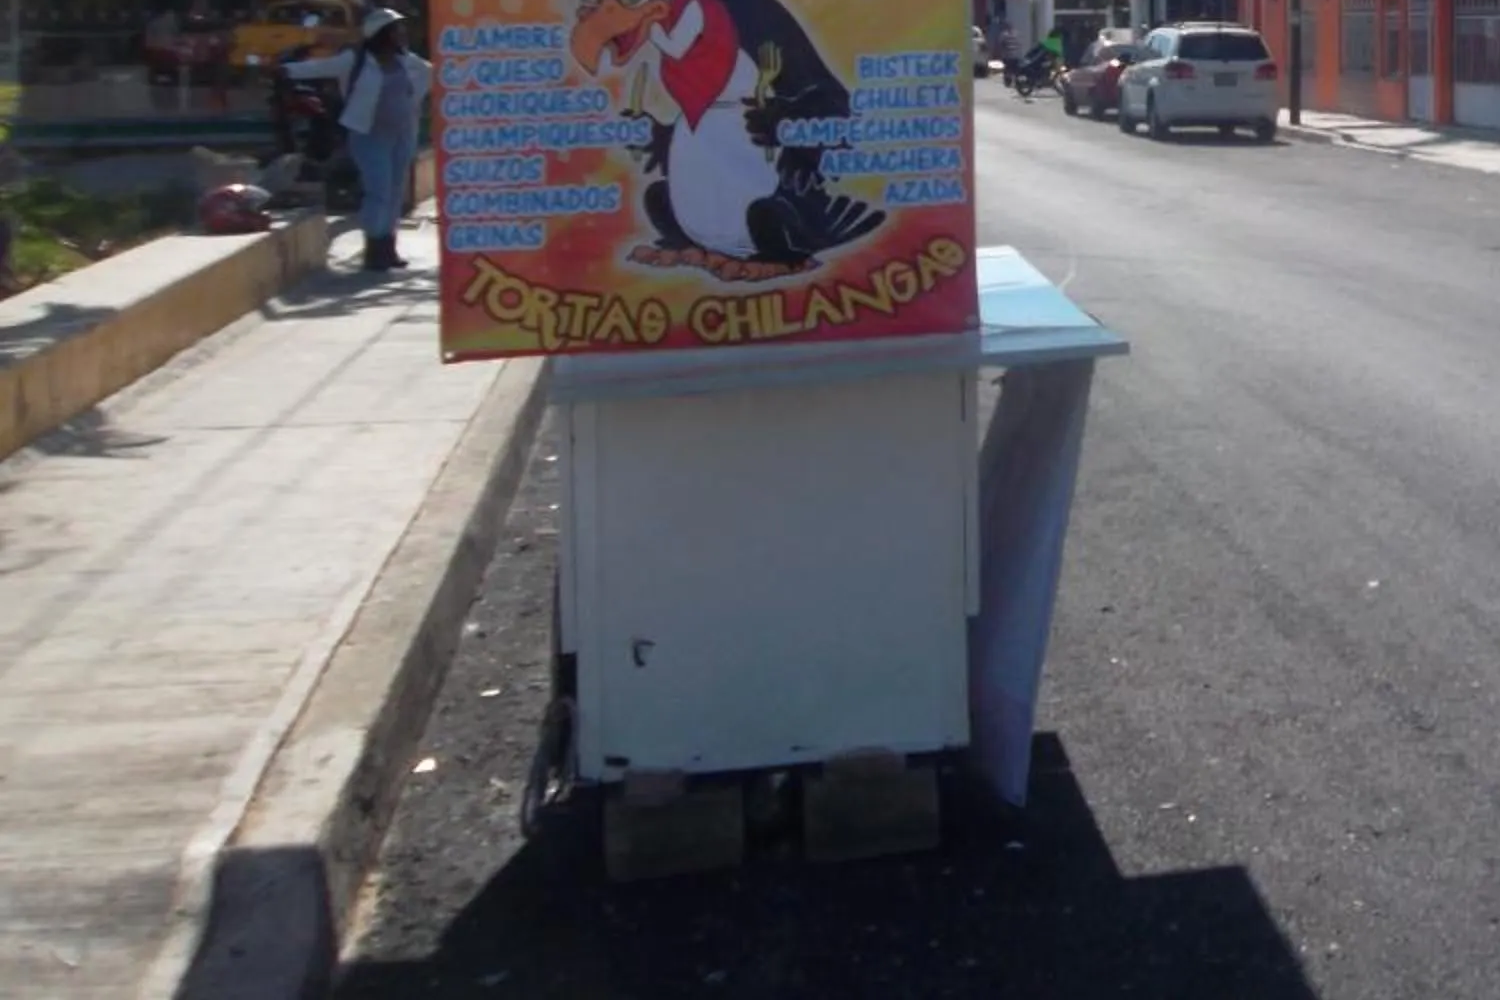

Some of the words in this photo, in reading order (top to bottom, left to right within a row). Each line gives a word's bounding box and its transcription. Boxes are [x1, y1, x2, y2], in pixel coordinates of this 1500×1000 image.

[441, 25, 565, 50] ALAMBRE
[441, 58, 564, 84] C/QUESO
[858, 52, 961, 79] BISTECK
[443, 88, 609, 117] CHORIQUESO
[851, 84, 961, 112] CHULETA
[444, 119, 651, 150] CHAMPIQUESOS
[778, 116, 961, 144] CAMPECHANOS
[446, 155, 545, 182] SUIZOS
[821, 146, 961, 174] ARRACHERA
[447, 185, 622, 216] COMBINADOS
[884, 178, 964, 204] AZADA
[462, 251, 672, 351] TORTAS
[687, 235, 967, 344] CHILANGAS
